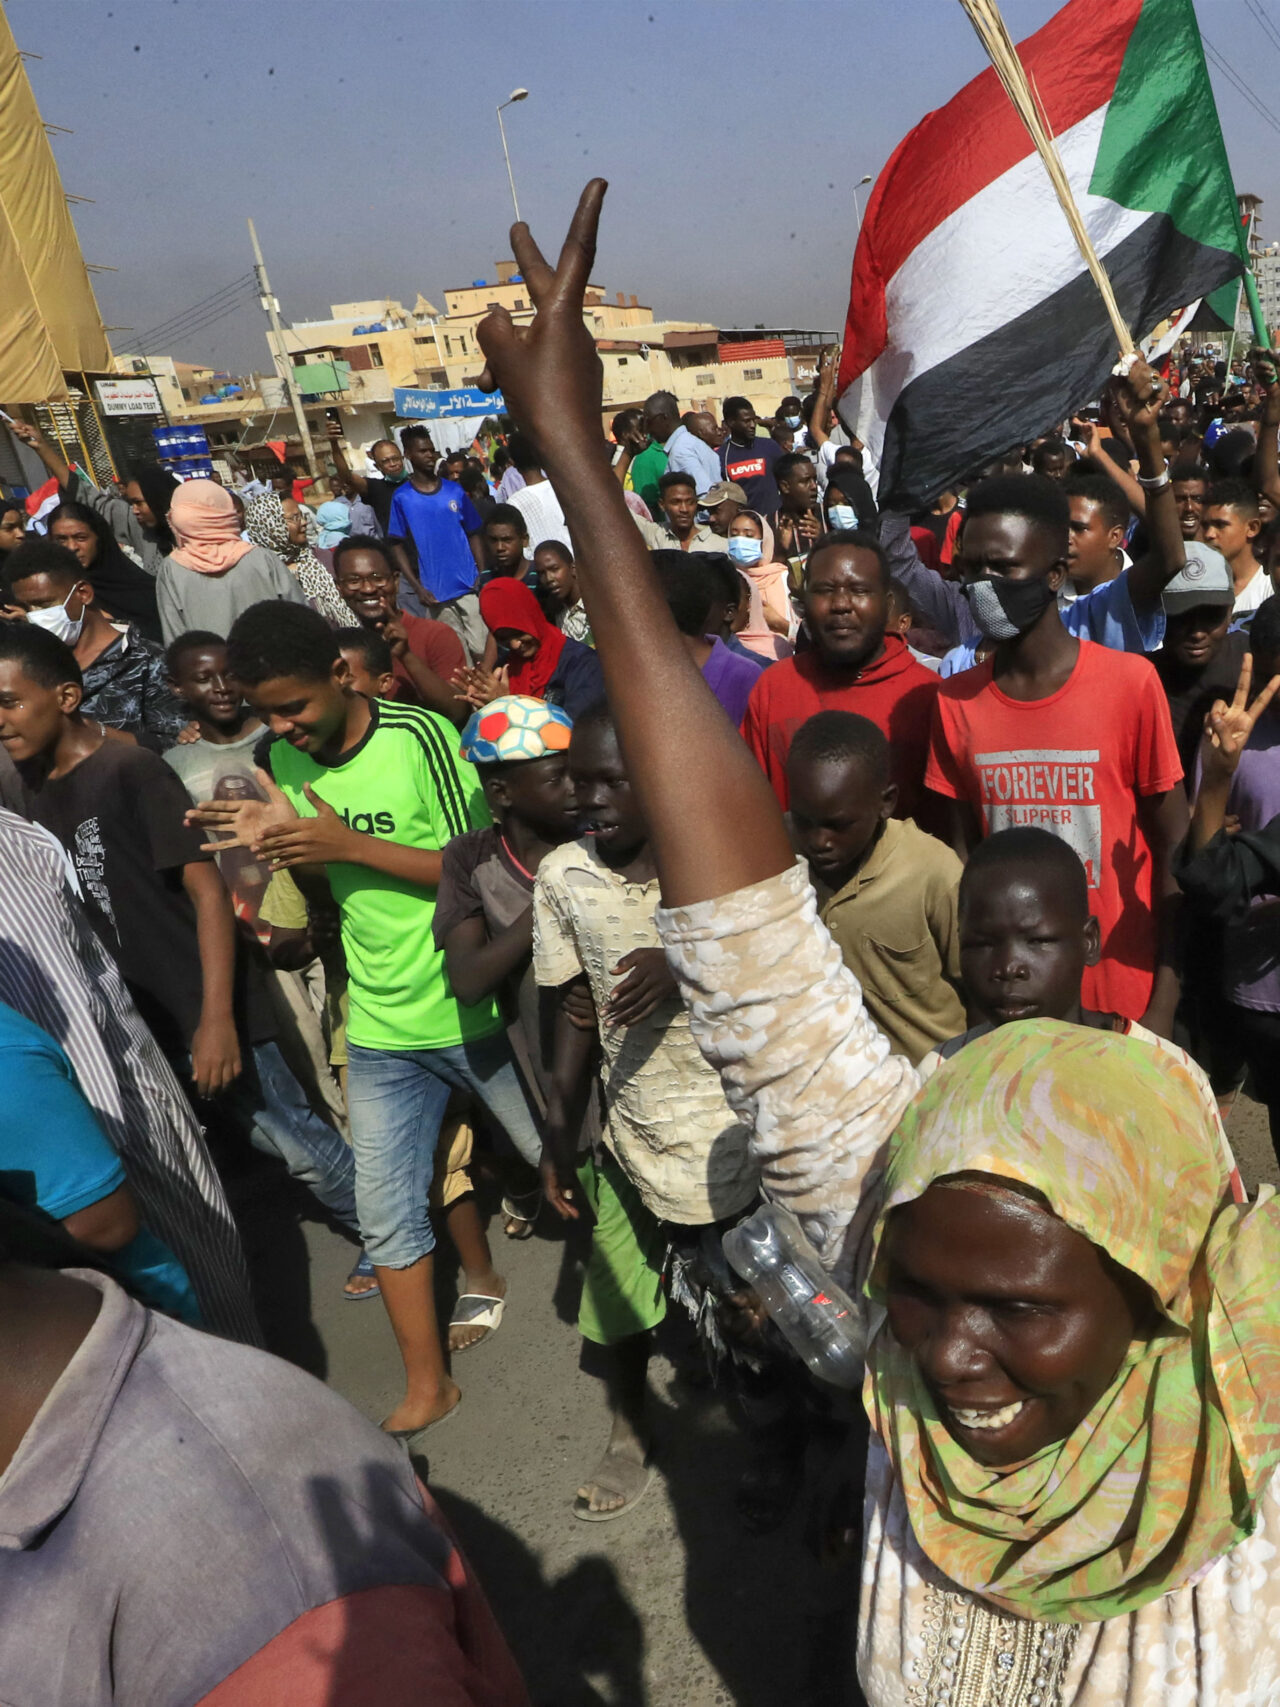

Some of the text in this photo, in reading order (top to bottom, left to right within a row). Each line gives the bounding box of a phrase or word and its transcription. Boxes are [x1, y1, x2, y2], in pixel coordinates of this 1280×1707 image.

[107, 402, 156, 411] DUMMY LOAD TEST
[980, 765, 1096, 800] FOREVER
[1004, 808, 1072, 825] SLIPPER
